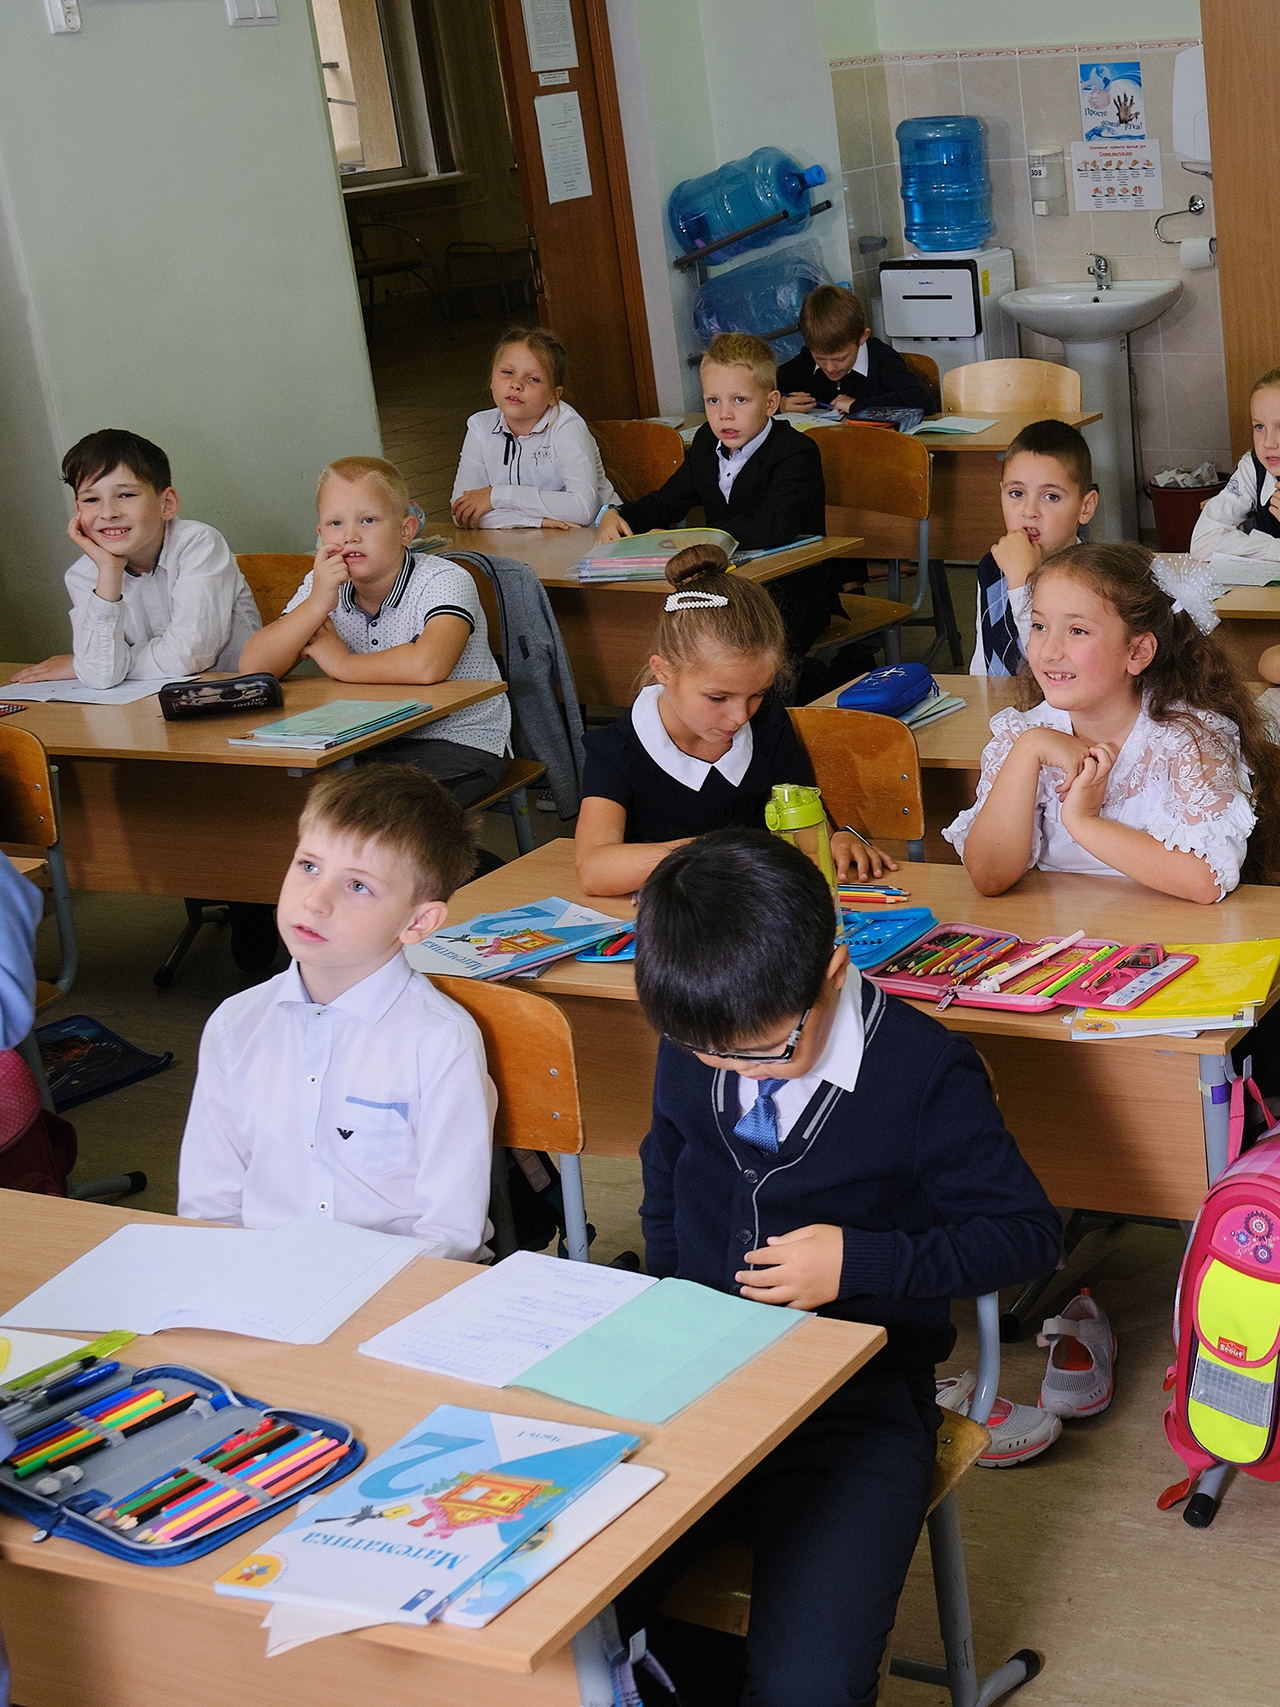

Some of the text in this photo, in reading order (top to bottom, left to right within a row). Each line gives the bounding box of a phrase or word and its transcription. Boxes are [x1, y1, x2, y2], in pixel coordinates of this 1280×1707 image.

[1084, 107, 1108, 117] Просто
[470, 906, 556, 935] 2
[420, 939, 488, 971] Математика
[1220, 1344, 1245, 1358] Scout
[529, 1432, 561, 1442] Часть
[358, 1431, 485, 1500] 2
[301, 1531, 471, 1571] Математика
